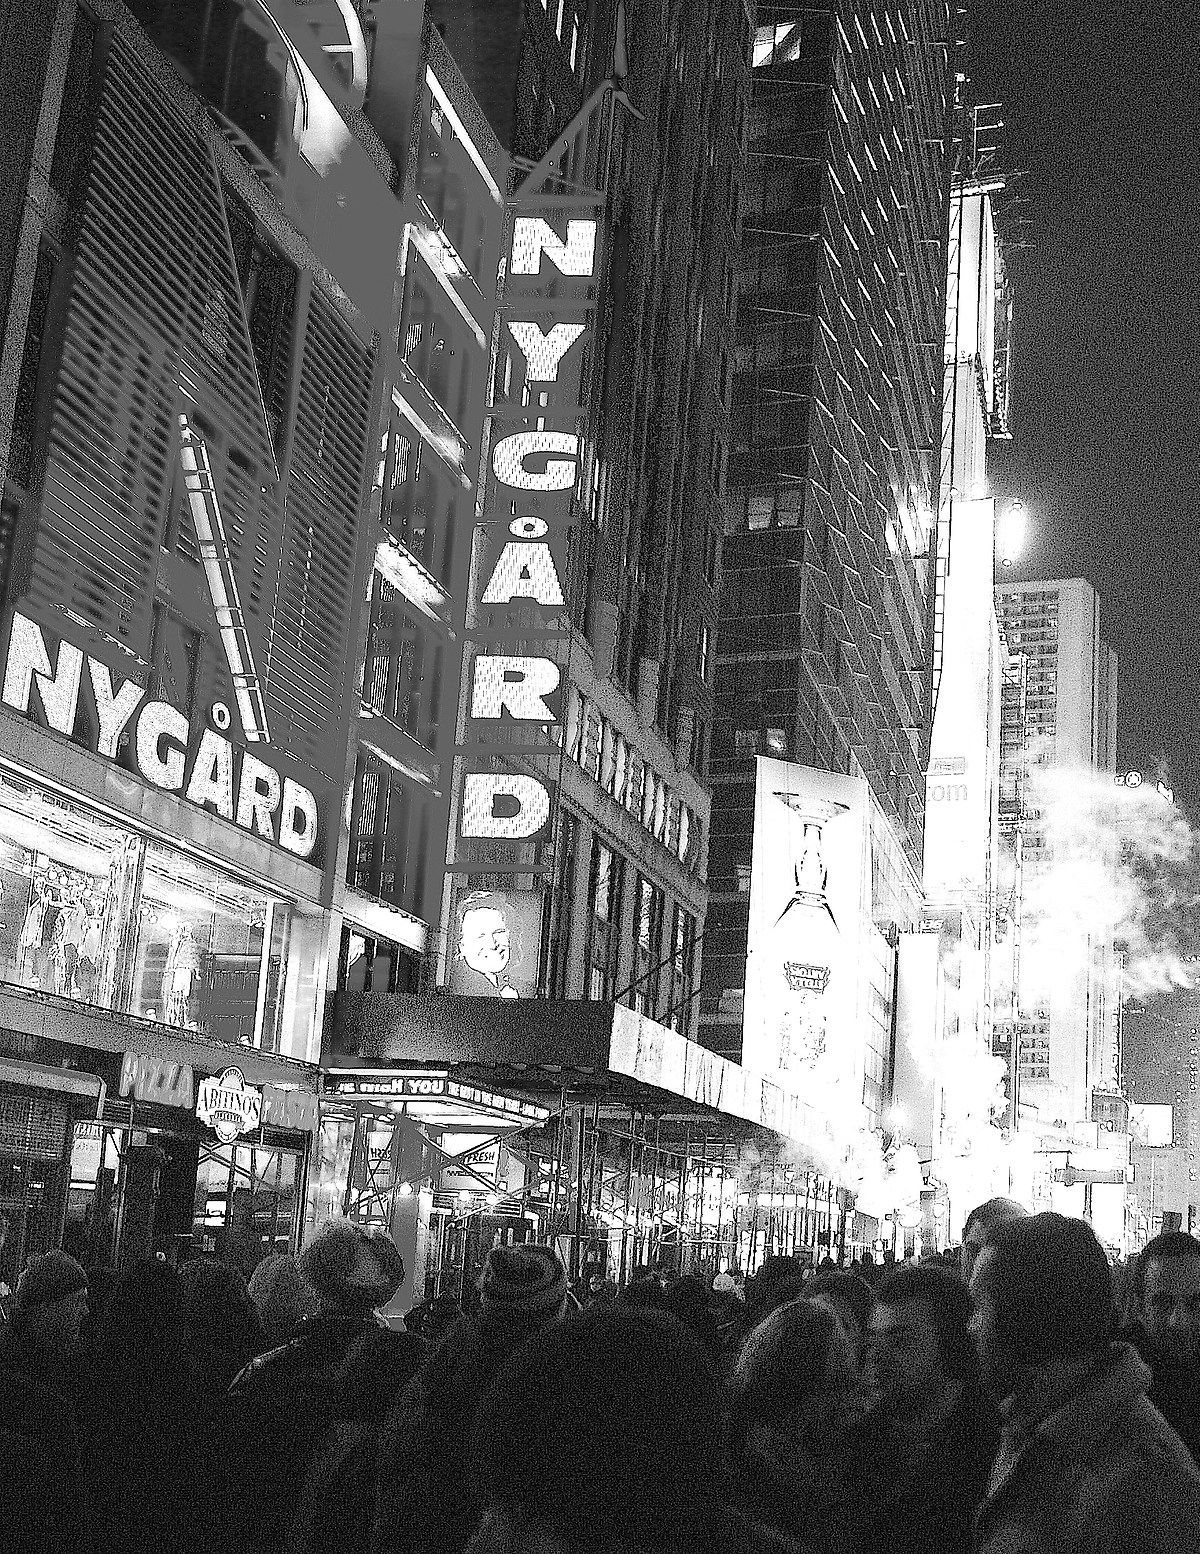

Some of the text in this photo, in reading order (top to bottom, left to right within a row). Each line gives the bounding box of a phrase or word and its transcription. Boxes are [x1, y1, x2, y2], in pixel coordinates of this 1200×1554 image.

[460, 217, 597, 840] NYGÅRD
[2, 611, 318, 857] NYGÅRD
[197, 1086, 261, 1122] ABITINO'S
[408, 1079, 444, 1095] YOU
